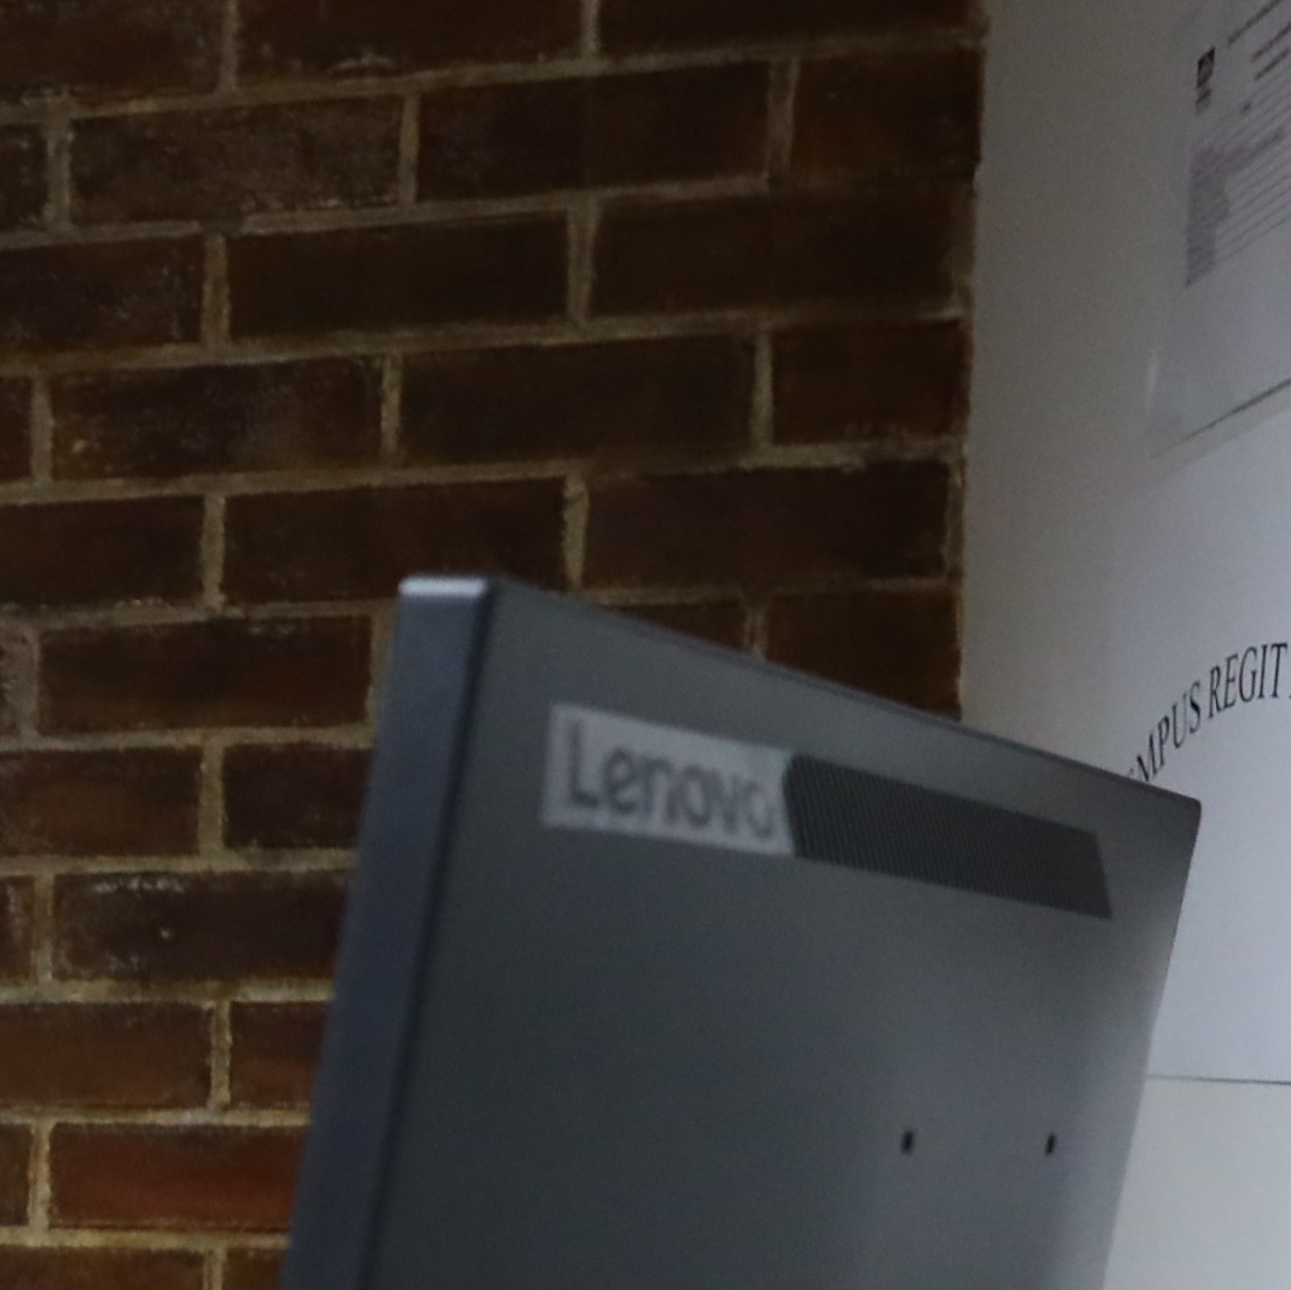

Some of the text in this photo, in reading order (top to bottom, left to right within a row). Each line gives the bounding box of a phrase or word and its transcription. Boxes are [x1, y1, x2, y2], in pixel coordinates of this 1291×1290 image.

[565, 717, 778, 840] Lenovo
[1125, 642, 1289, 783] MPUS REGIT
